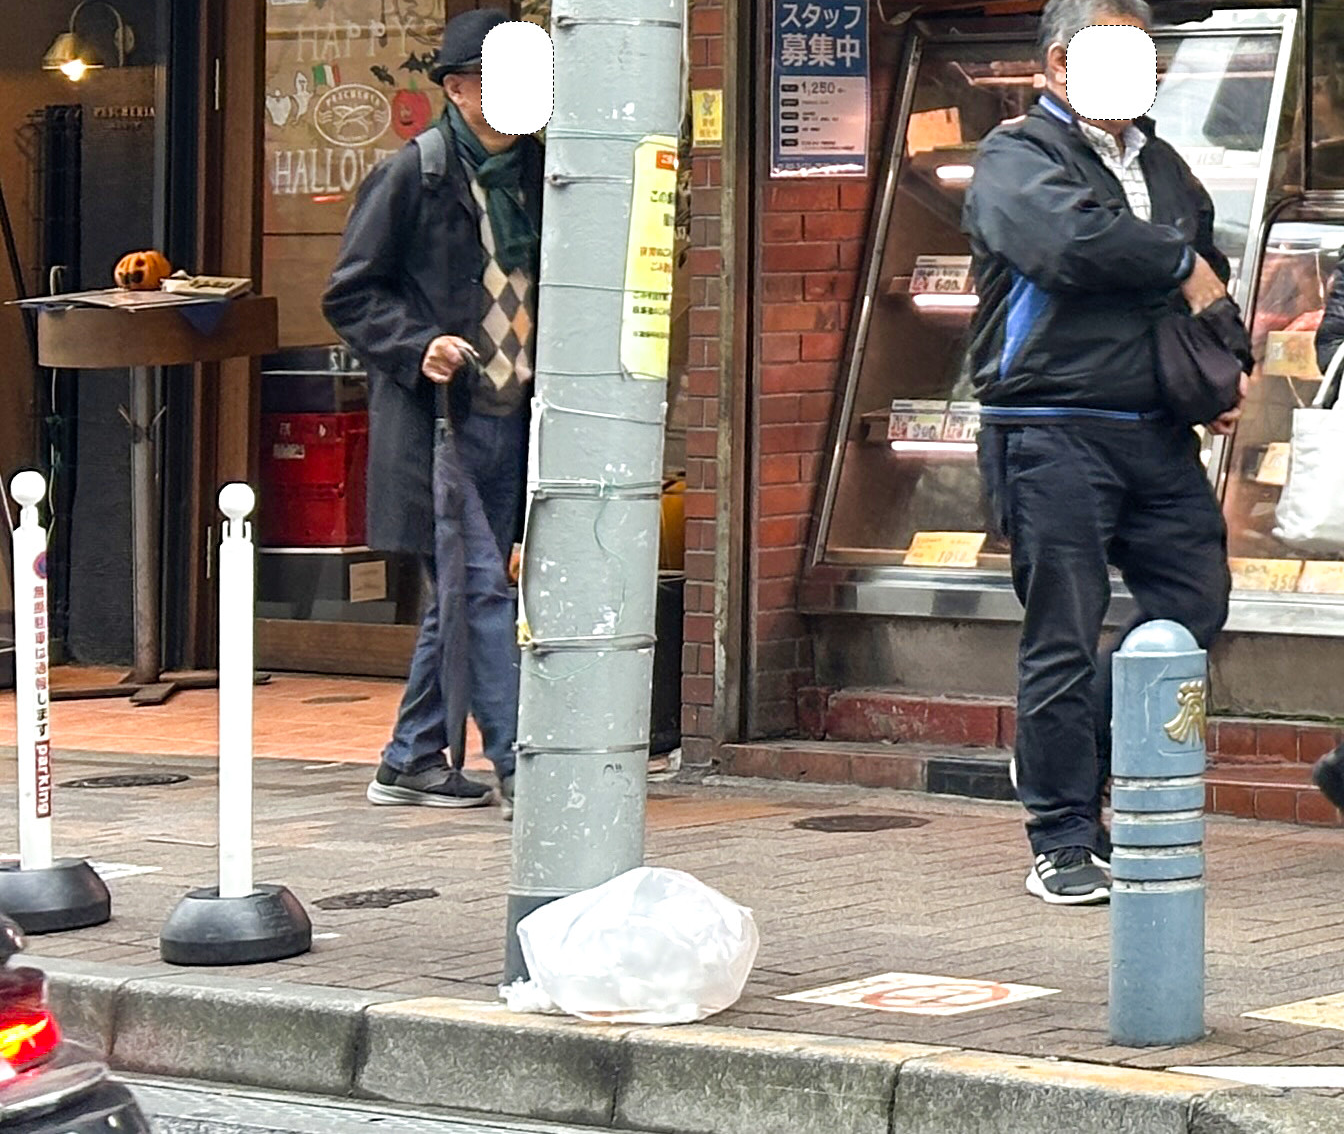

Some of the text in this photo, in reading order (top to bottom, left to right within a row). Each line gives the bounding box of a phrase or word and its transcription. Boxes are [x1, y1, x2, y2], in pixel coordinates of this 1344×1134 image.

[780, 3, 862, 30] スタッフ
[296, 15, 417, 62] HAPPY
[781, 33, 861, 68] 募集中
[36, 742, 50, 815] parking
